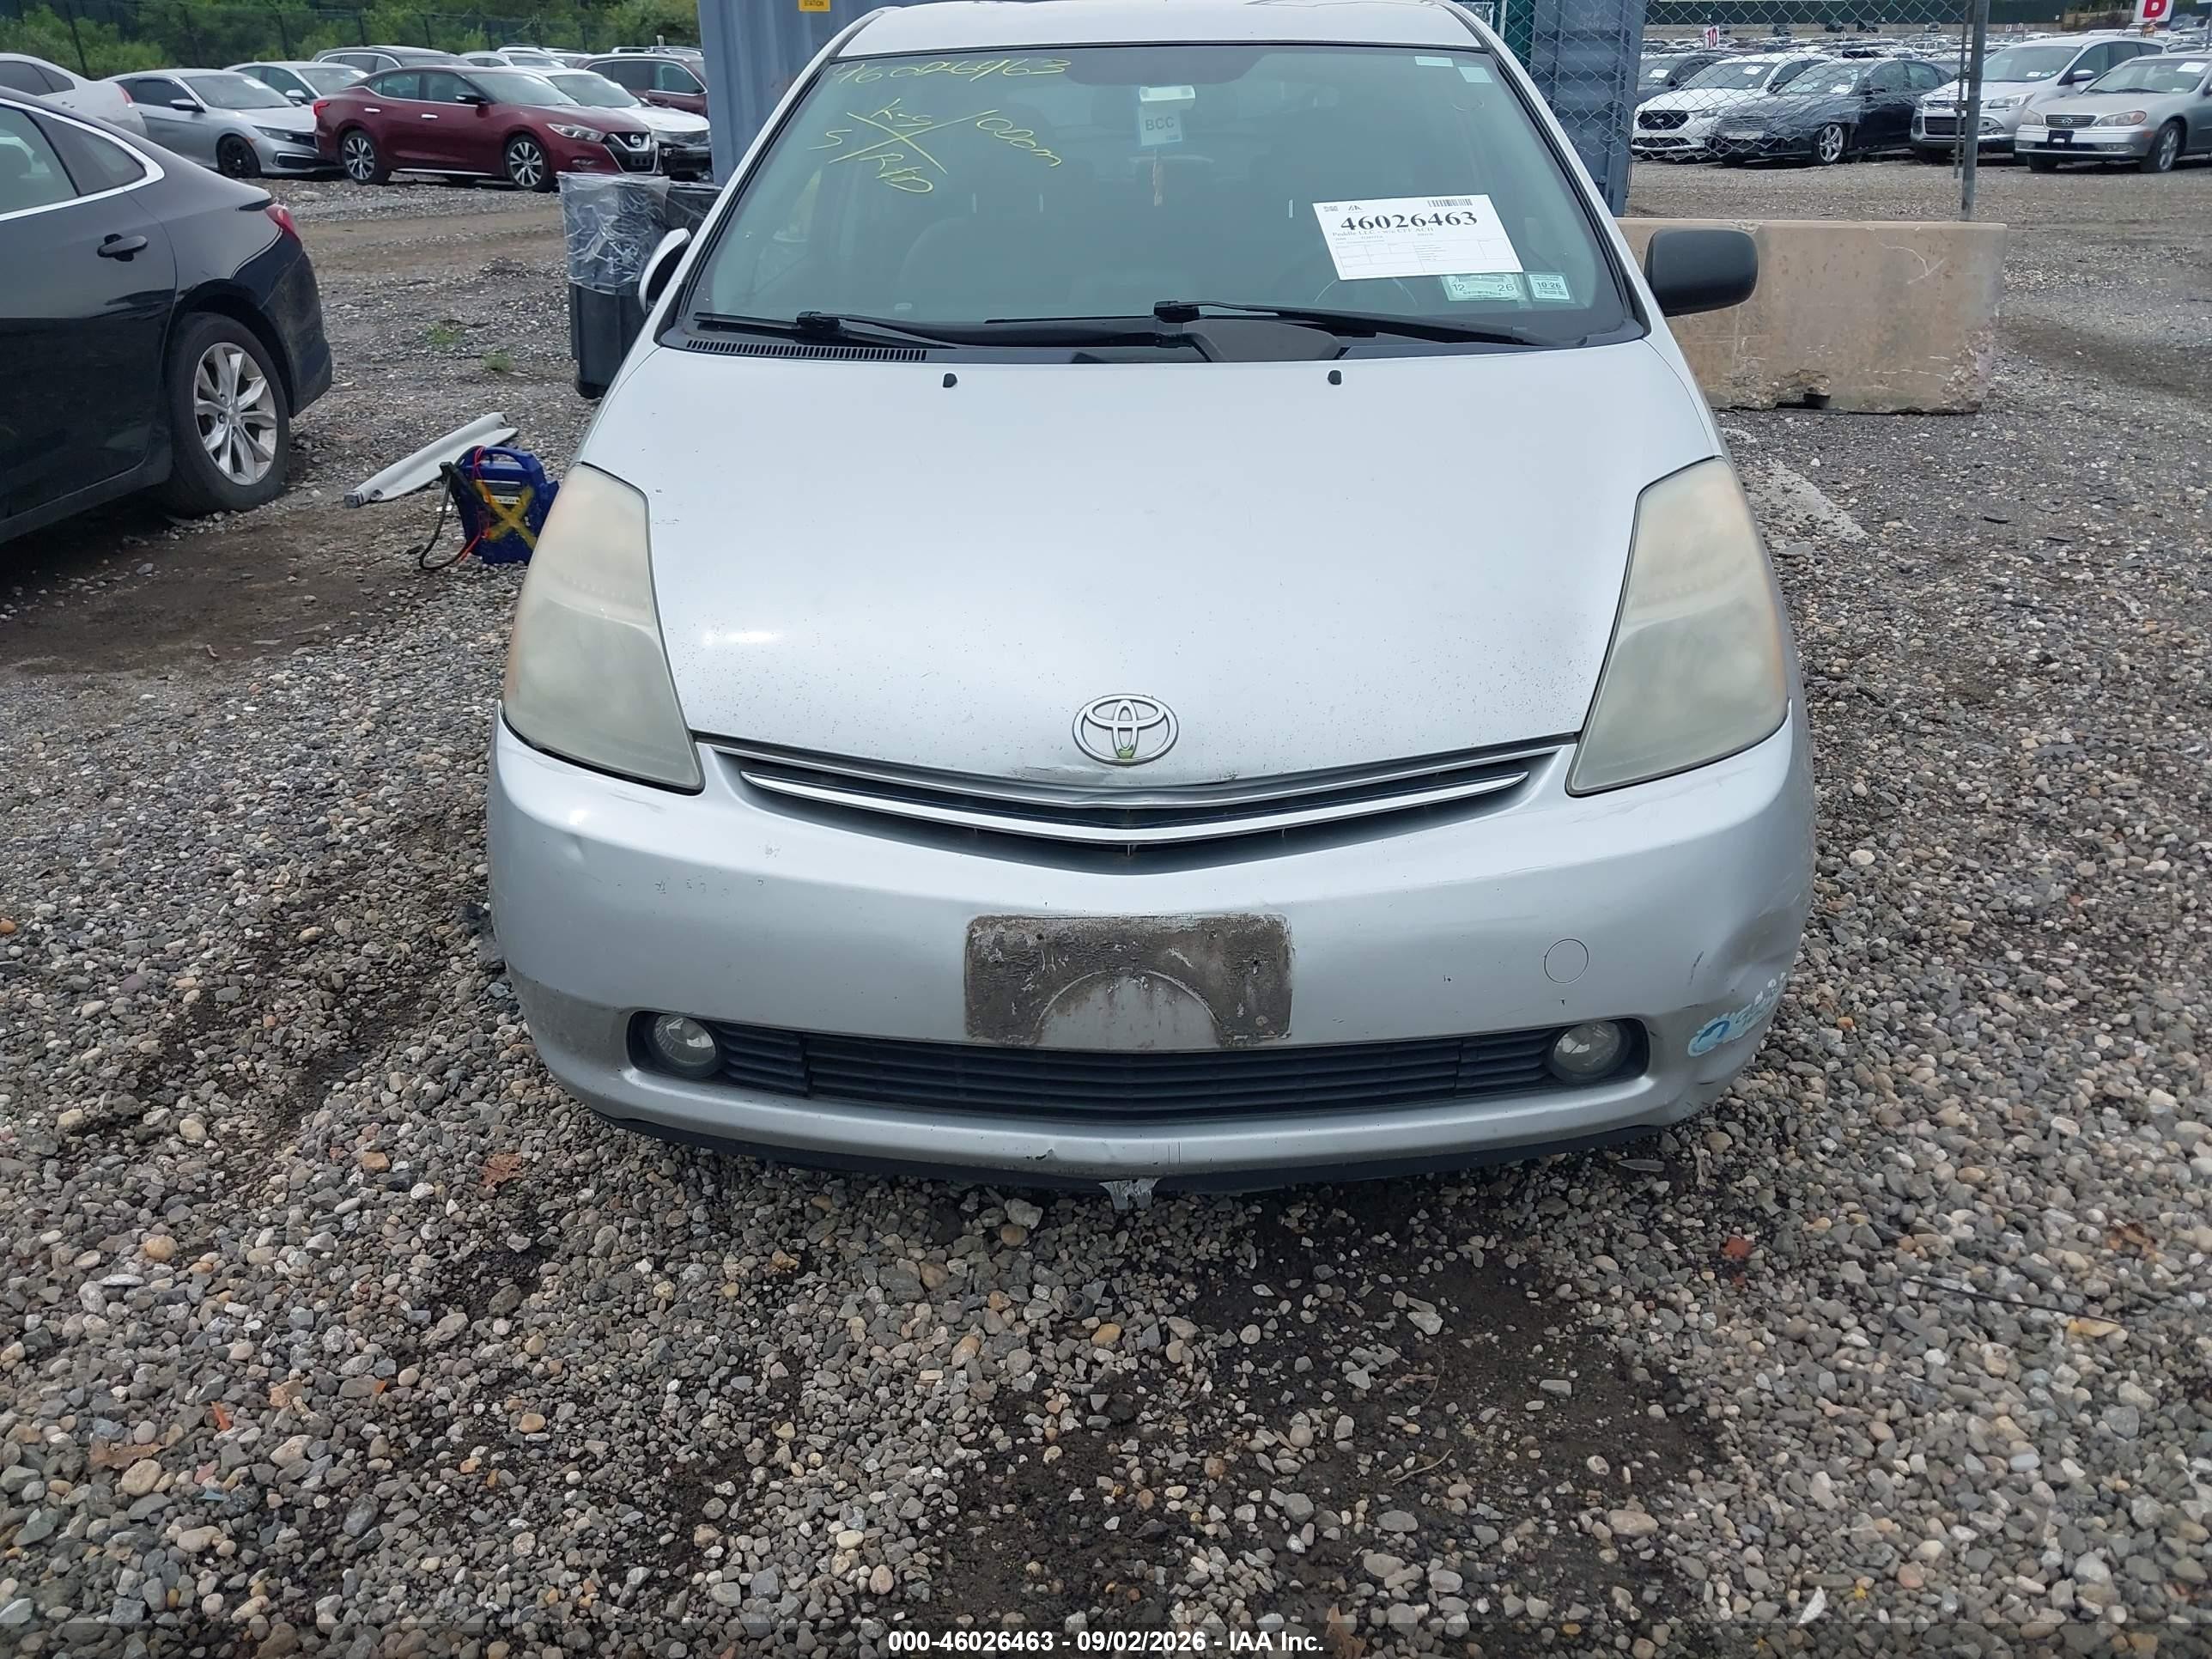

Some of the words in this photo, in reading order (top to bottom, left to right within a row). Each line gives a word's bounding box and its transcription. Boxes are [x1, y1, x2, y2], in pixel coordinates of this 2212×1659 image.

[1146, 117, 1175, 131] BCC
[1340, 211, 1478, 231] 46026463
[1497, 283, 1515, 292] 26
